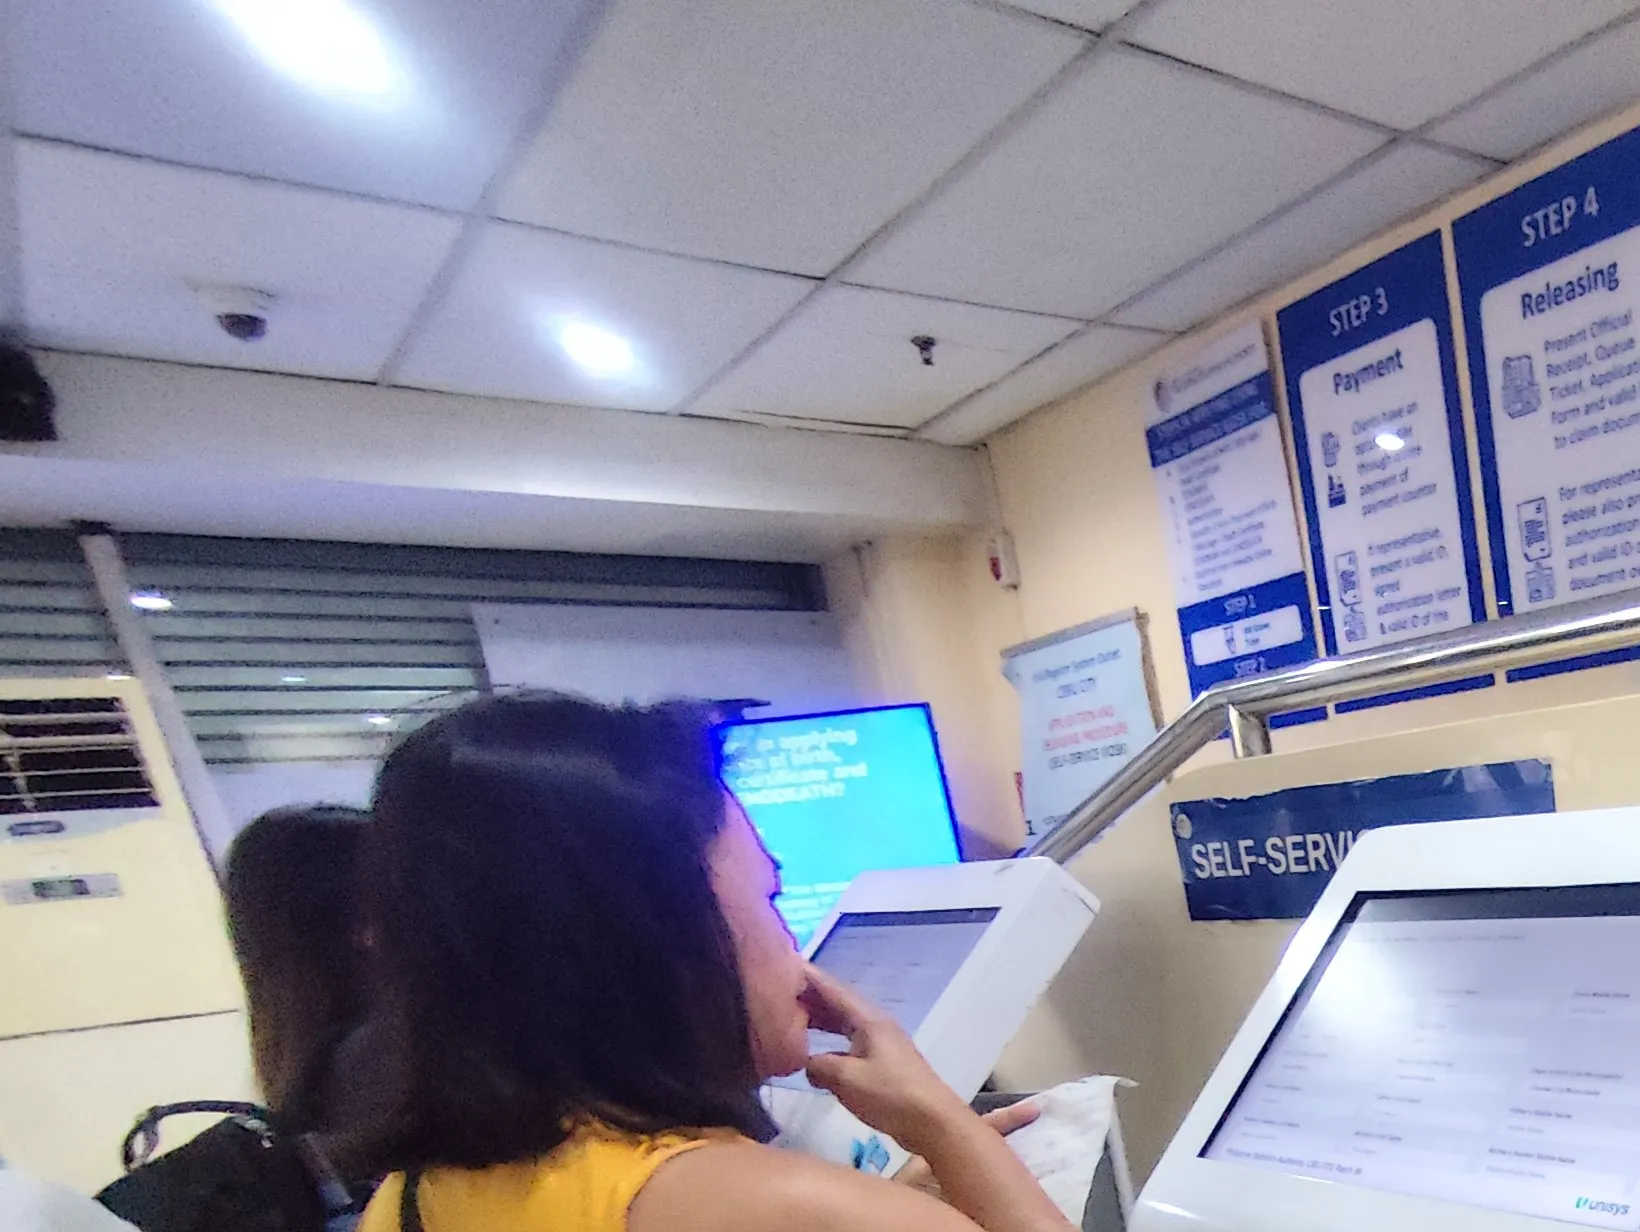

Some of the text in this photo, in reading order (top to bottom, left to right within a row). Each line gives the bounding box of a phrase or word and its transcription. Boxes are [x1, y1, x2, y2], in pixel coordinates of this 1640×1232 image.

[1521, 186, 1600, 247] STEP 4
[1521, 261, 1620, 319] Releasing
[1329, 287, 1389, 337] STEP 3
[1595, 337, 1635, 361] Queue
[1333, 347, 1404, 395] Payment
[1584, 395, 1606, 415] and
[1608, 384, 1637, 406] valid
[1554, 436, 1567, 449] to
[1559, 486, 1577, 501] For
[1562, 506, 1597, 525] please
[1602, 498, 1624, 514] also
[1568, 552, 1588, 569] and
[1592, 544, 1618, 563] valid
[1620, 541, 1634, 556] ID
[1569, 568, 1626, 591] document
[1223, 594, 1257, 616] STEP 1
[1234, 658, 1258, 677] STEP
[1191, 829, 1370, 879] SELF-SERVI
[1588, 1201, 1631, 1216] unisys
